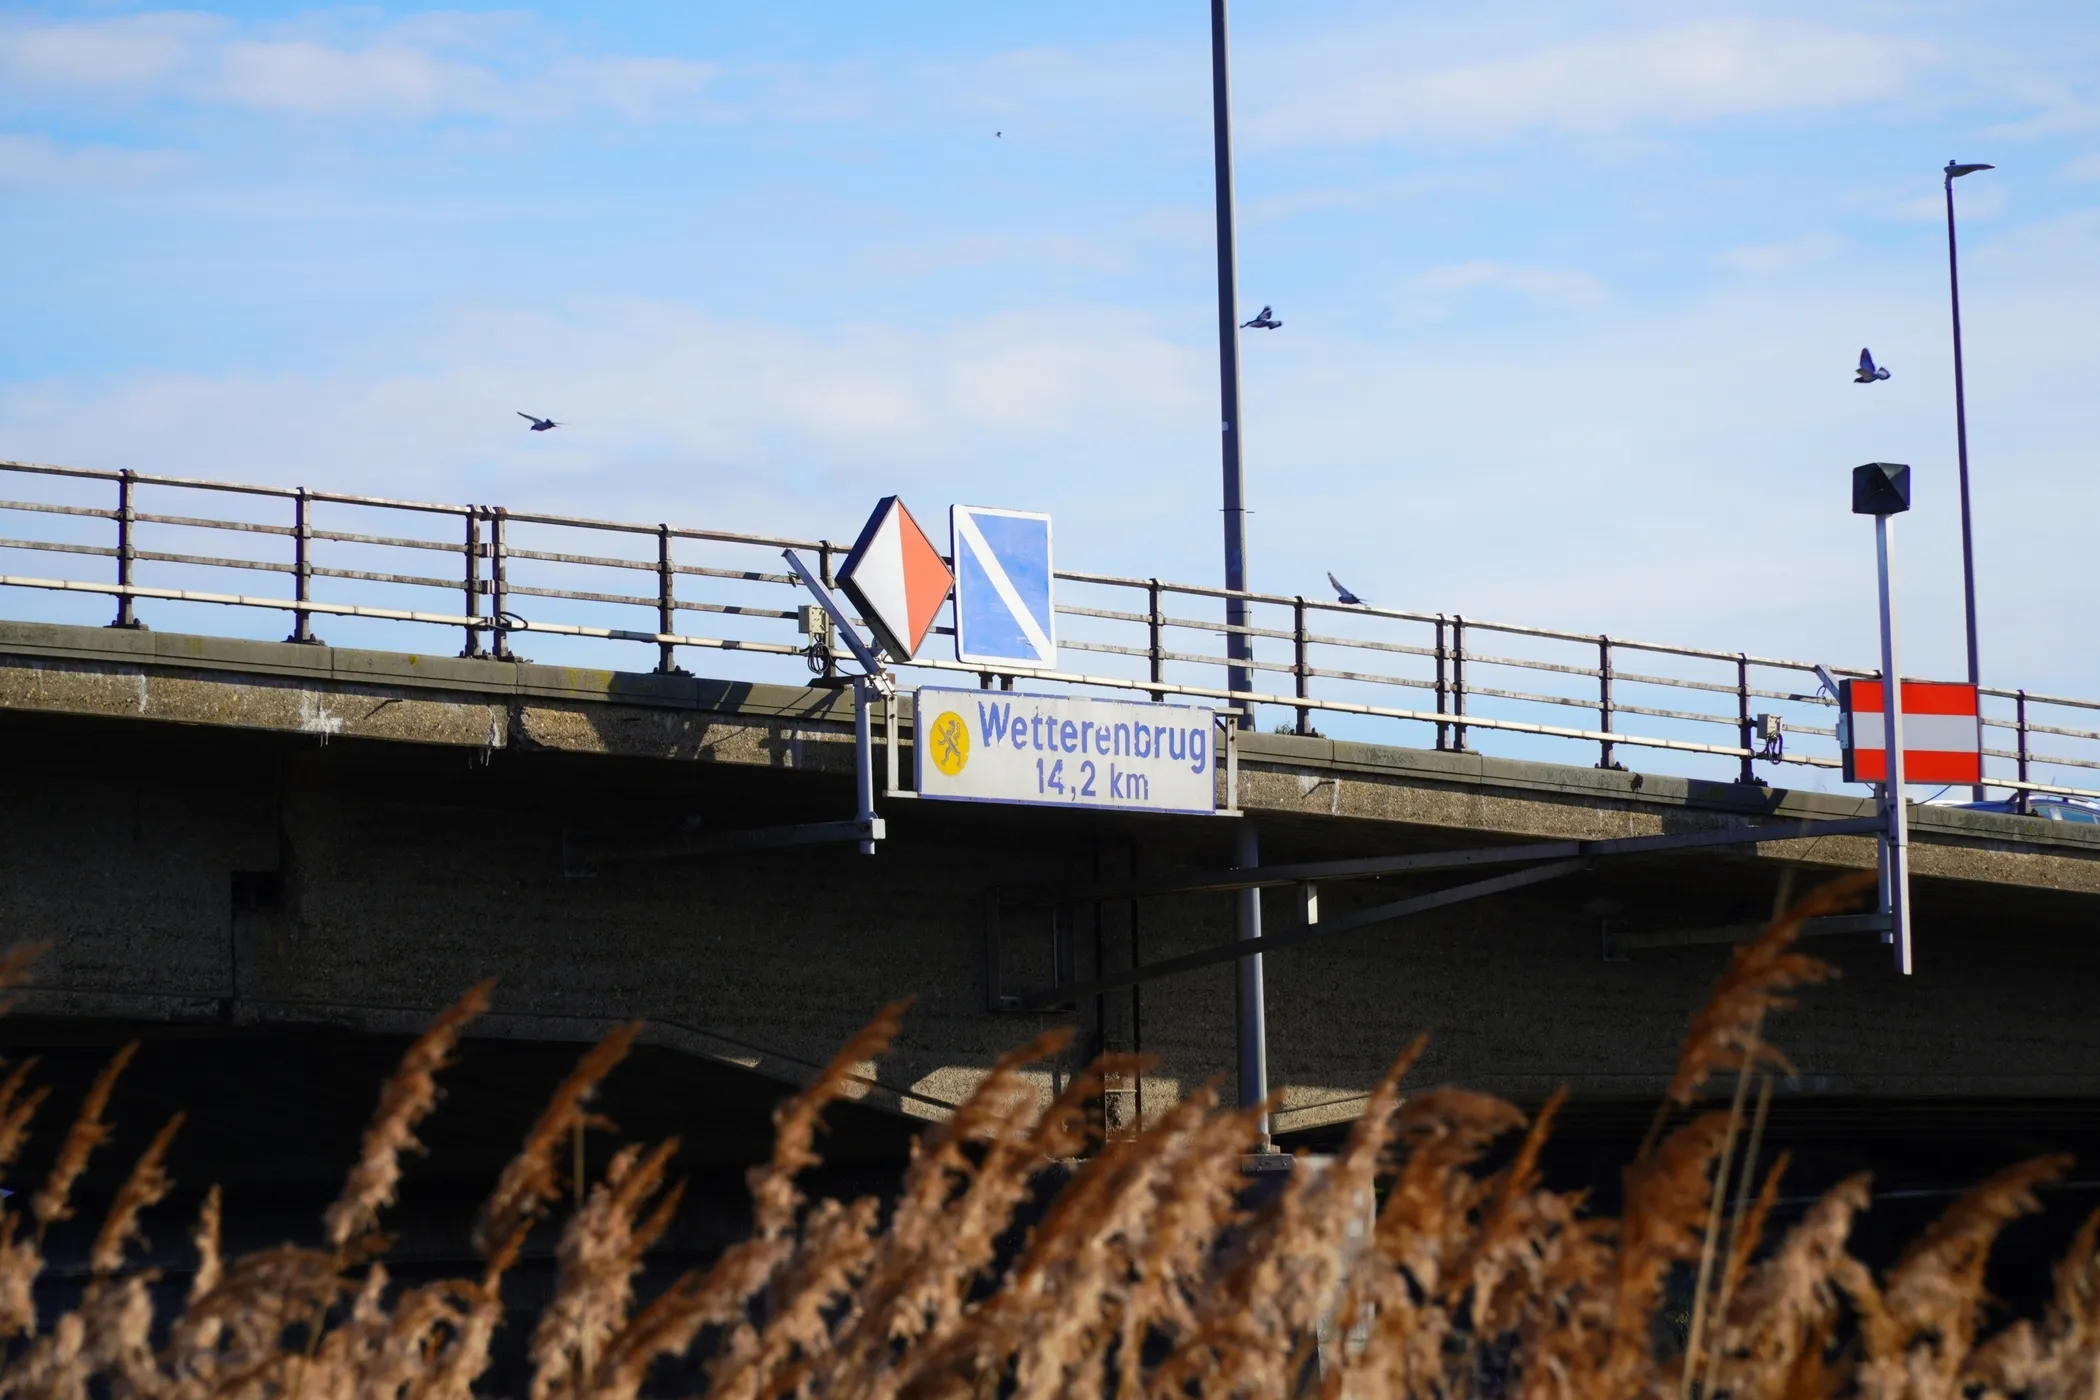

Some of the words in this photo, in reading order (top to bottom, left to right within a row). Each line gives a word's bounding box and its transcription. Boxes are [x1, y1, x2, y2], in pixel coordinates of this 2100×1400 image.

[978, 701, 1206, 774] Wetterenbrug
[1036, 758, 1096, 801] 14,2
[1110, 763, 1149, 800] km
